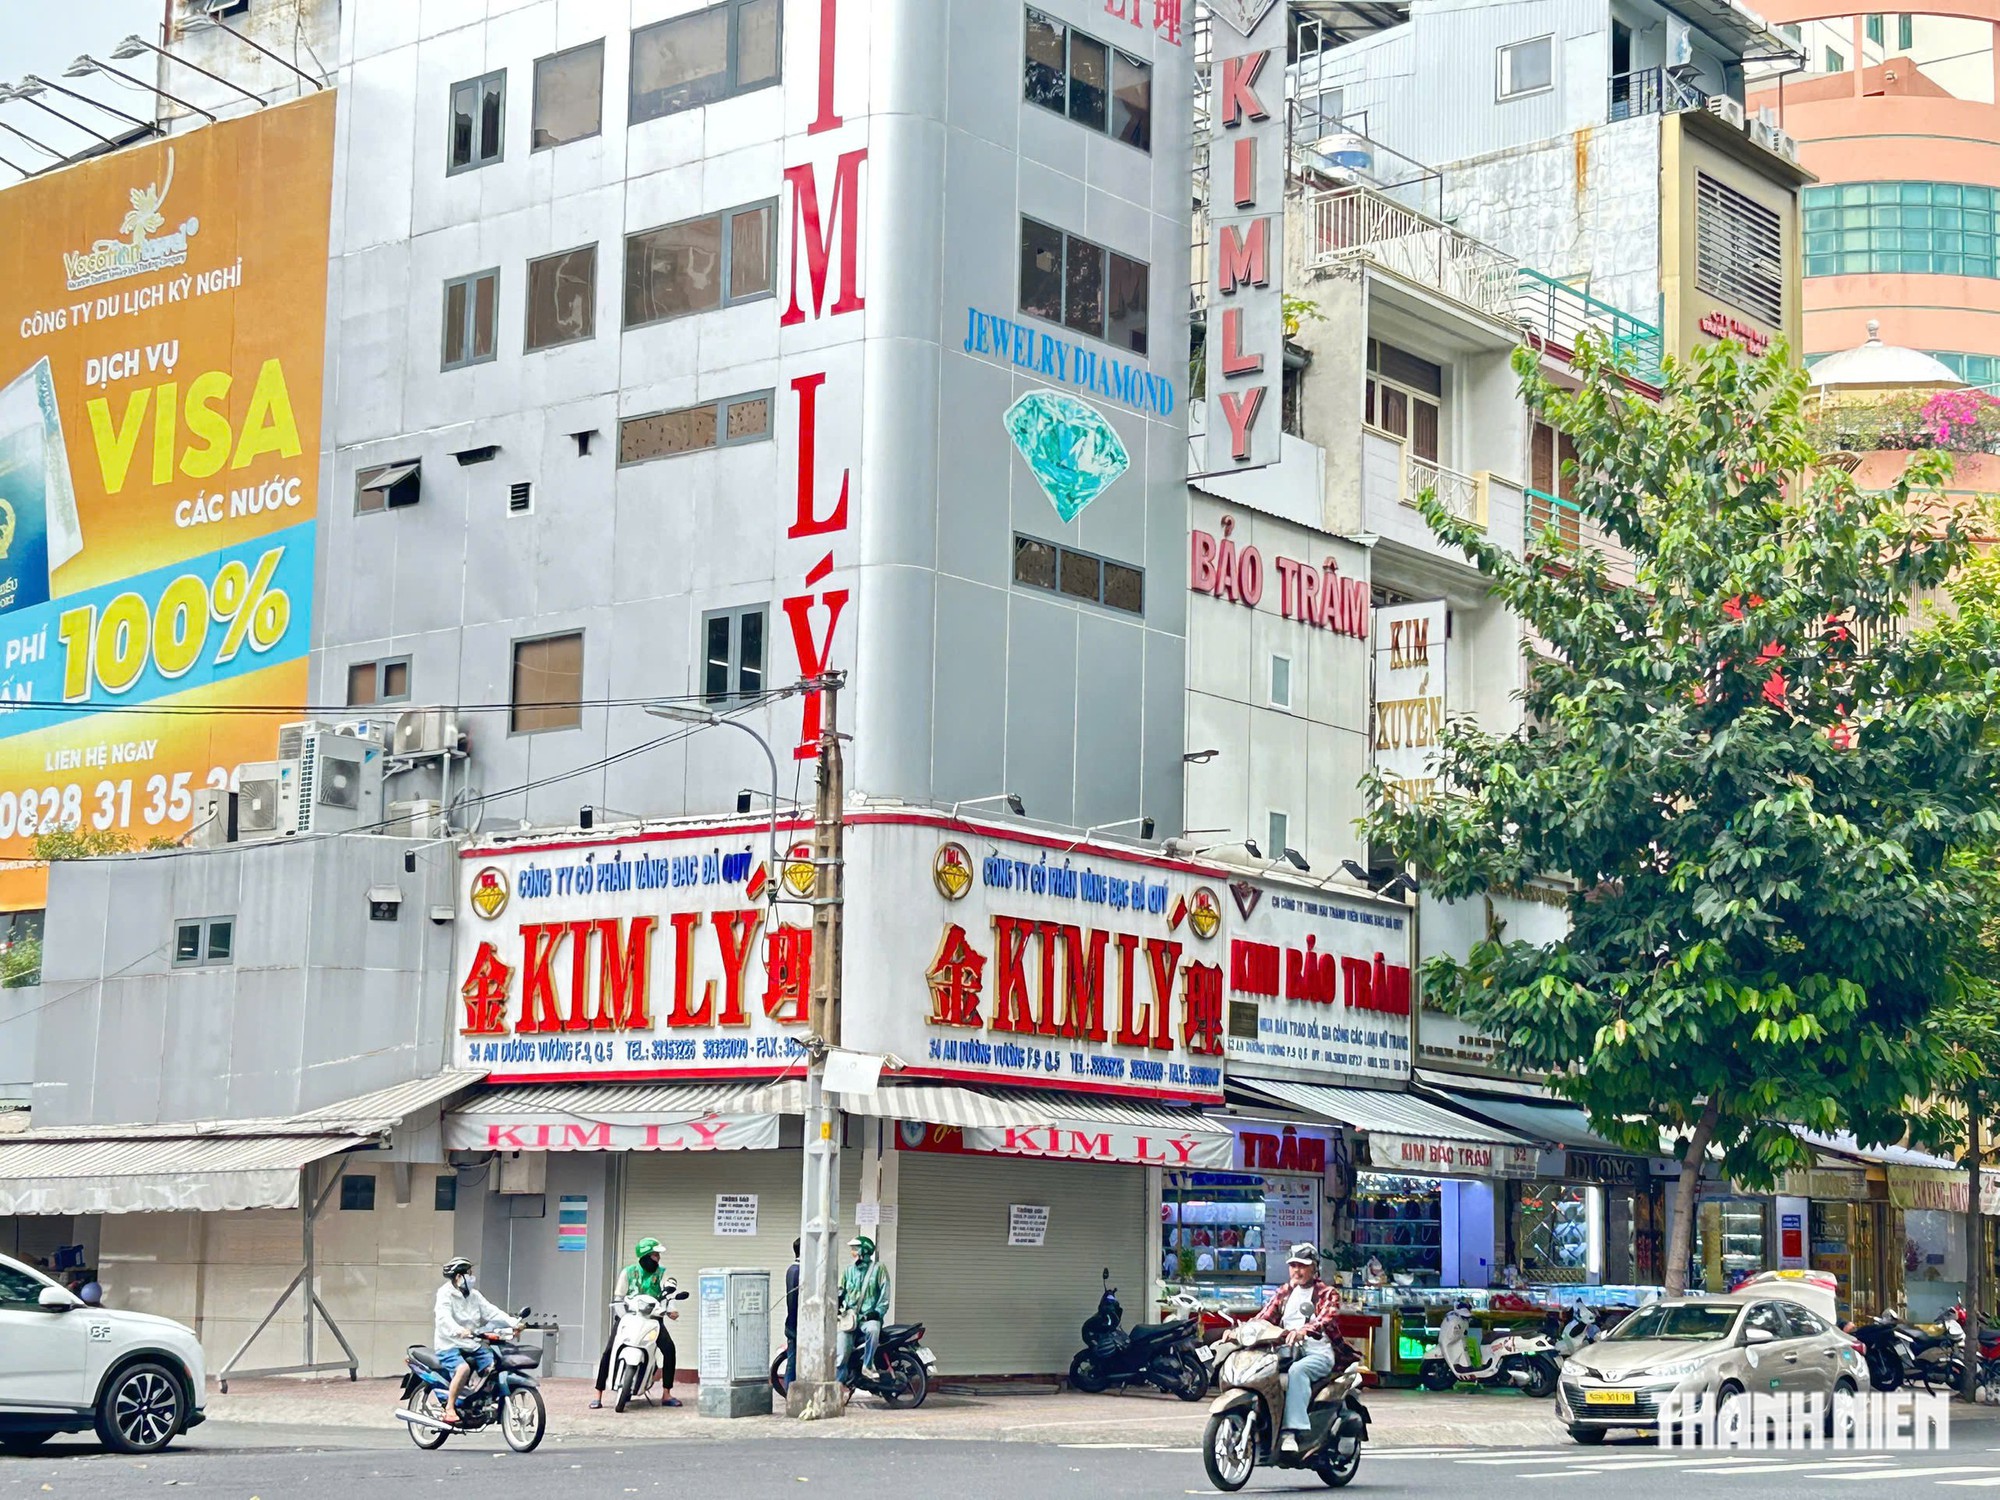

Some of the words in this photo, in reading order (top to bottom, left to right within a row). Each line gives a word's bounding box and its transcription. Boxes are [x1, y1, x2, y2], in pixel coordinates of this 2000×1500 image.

[20, 308, 66, 338] CÔNG
[70, 301, 93, 326] TY
[96, 295, 120, 321] DU
[124, 284, 164, 316] LỊCH
[168, 272, 192, 303] KỲ
[197, 257, 243, 296] NGHỈ
[86, 349, 140, 389] DỊCH
[145, 340, 179, 375] VỤ
[963, 307, 1072, 384] JEWELRY
[1073, 345, 1174, 417] DIAMOND
[86, 358, 303, 495] VISA
[175, 490, 224, 529] CÁC
[230, 474, 301, 518] NƯỚC
[1192, 515, 1263, 608] BẢO
[1277, 555, 1369, 639] TRÂM
[5, 623, 48, 669] PHÍ
[58, 546, 290, 704] 100%
[1390, 618, 1429, 670] KIM
[1376, 672, 1442, 750] XUYẾN
[85, 741, 107, 770] HỆ
[111, 739, 158, 764] NGAY
[0, 779, 82, 839] 0828
[92, 779, 133, 831] 31
[144, 772, 193, 826] 35
[518, 862, 551, 899] CÔNG
[556, 866, 575, 895] TY
[575, 852, 595, 895] CỔ
[634, 853, 669, 889] VÀNG
[983, 852, 1013, 889] CÔNG
[1014, 861, 1031, 892] TY
[1031, 851, 1046, 895] CỔ
[1080, 867, 1107, 904] VÀNG
[1108, 876, 1130, 912] BẠC
[1131, 875, 1146, 911] ĐÁ
[1148, 879, 1169, 914] QUÝ
[459, 941, 515, 1036] 金
[515, 915, 658, 1034] KIM
[667, 861, 767, 1029] LÝ
[925, 922, 987, 1029] 金
[988, 914, 1109, 1043] KIM
[1112, 894, 1188, 1051] LÝ
[1230, 938, 1280, 996] KIM
[1286, 934, 1336, 1004] BẢO
[1341, 951, 1410, 1016] TRÂM
[483, 1042, 499, 1062] AN
[929, 1038, 941, 1060] 34
[943, 1039, 958, 1061] AN
[485, 1122, 613, 1148] KIM
[643, 1114, 734, 1148] LÝ
[1004, 1127, 1113, 1157] KIM
[1134, 1133, 1200, 1163] LÝ
[1239, 1125, 1325, 1172] TRÂM
[1401, 1143, 1425, 1161] KIM
